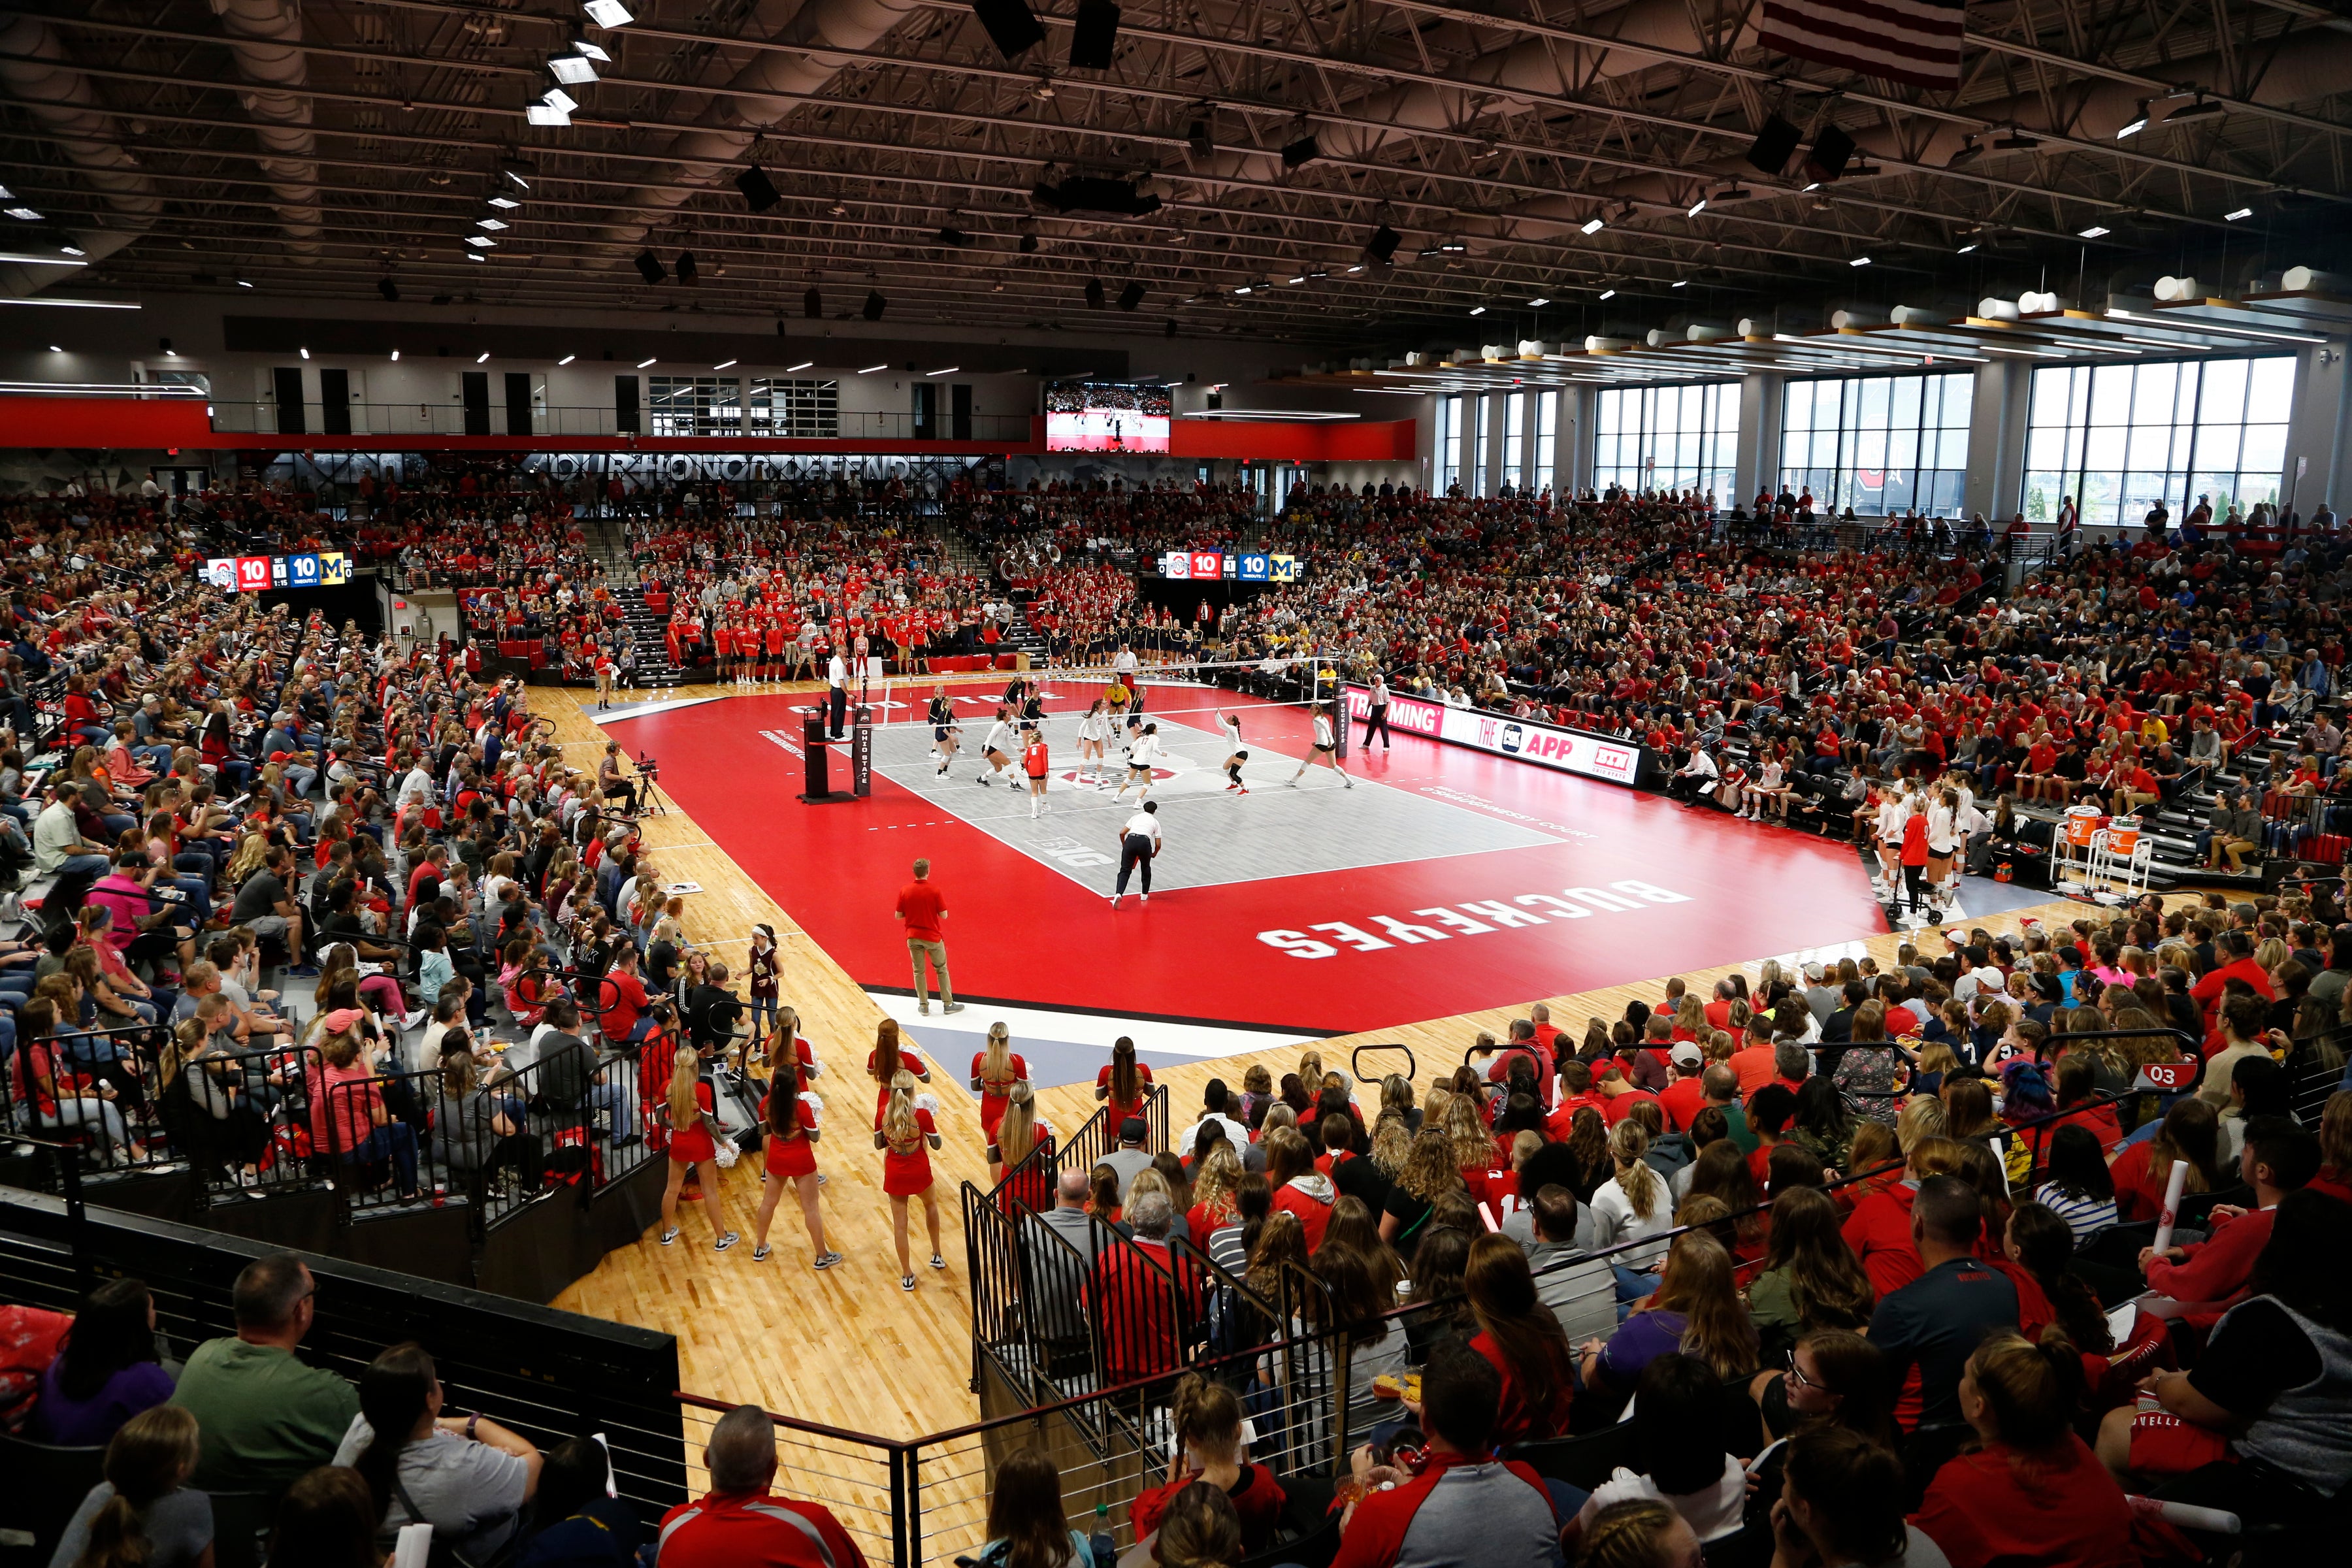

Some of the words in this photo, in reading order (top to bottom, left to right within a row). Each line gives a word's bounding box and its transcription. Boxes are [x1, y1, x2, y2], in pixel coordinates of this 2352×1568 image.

[551, 453, 637, 481] OUR
[639, 453, 770, 482] HONOR
[780, 454, 910, 481] DEFEND
[242, 560, 265, 581] 10
[294, 557, 316, 577] 10
[321, 558, 342, 579] M
[346, 568, 351, 578] 0
[1158, 565, 1166, 574] 0
[1195, 555, 1216, 572] 10
[1244, 557, 1265, 573] 10
[1270, 560, 1292, 577] M
[1478, 718, 1498, 747] THE
[1504, 728, 1522, 742] FOX
[1526, 734, 1573, 760] APP
[1031, 746, 1037, 756] 6
[1595, 747, 1629, 770] BTN
[1607, 771, 1626, 779] STATE
[1419, 787, 1541, 822] O'SHAUGHNESSY
[1538, 821, 1600, 840] COURT
[1256, 879, 1696, 960] BUCKEYES
[2150, 1066, 2175, 1085] 03
